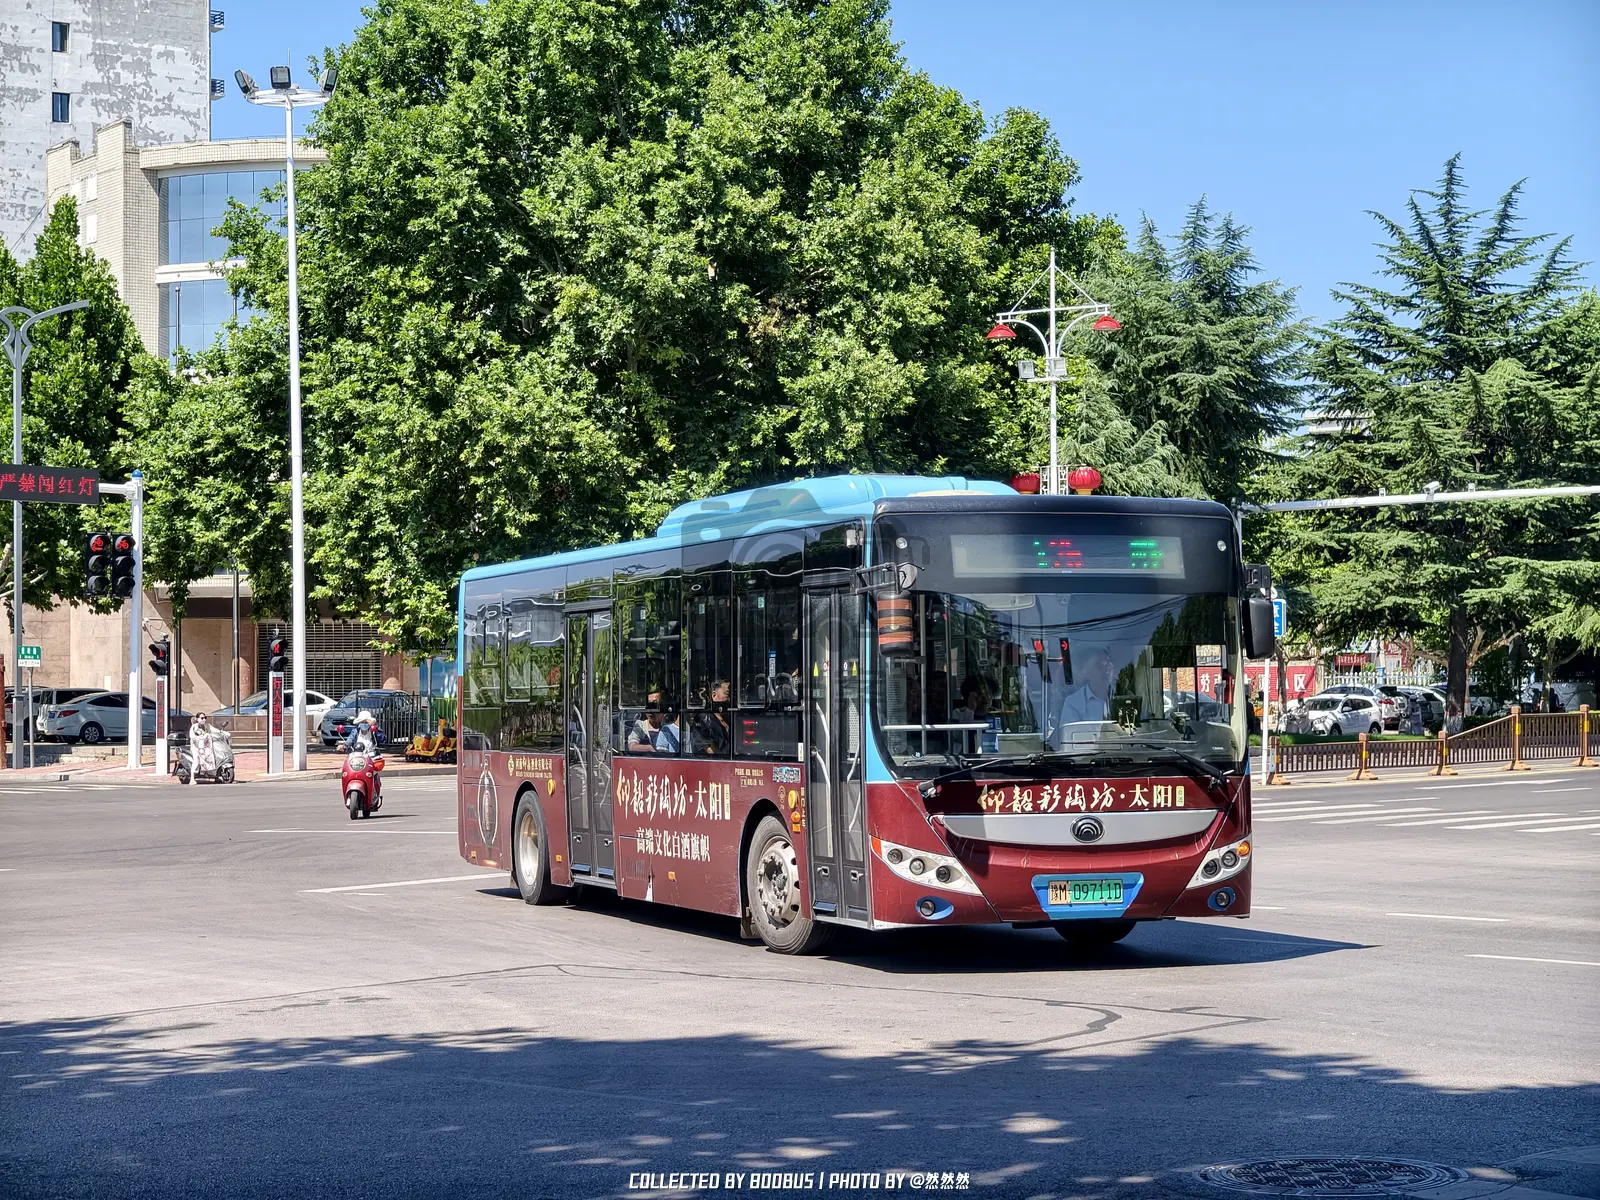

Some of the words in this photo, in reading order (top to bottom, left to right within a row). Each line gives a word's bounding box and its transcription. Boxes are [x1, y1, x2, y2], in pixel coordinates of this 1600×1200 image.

[0, 473, 96, 496] 严禁闯红灯
[636, 827, 711, 863] 高端文化白酒旗帜
